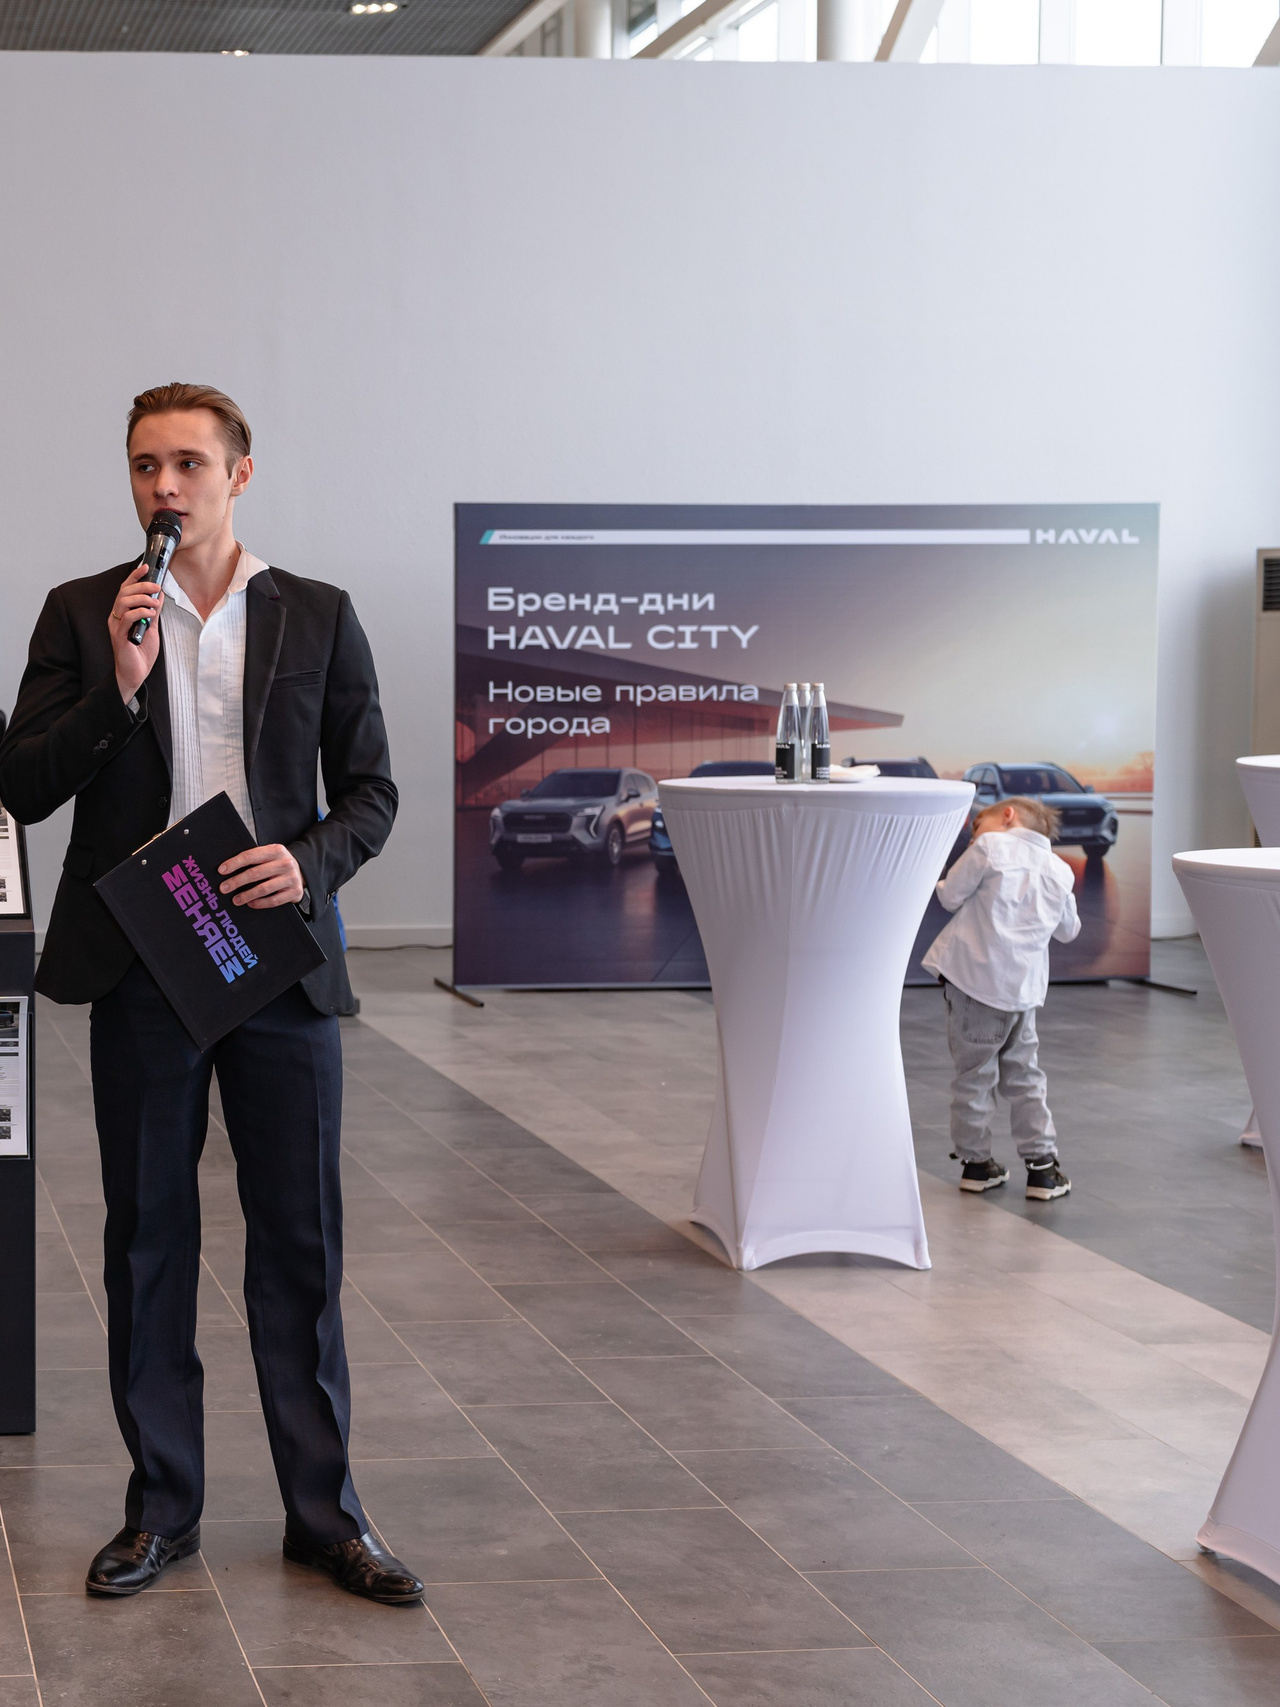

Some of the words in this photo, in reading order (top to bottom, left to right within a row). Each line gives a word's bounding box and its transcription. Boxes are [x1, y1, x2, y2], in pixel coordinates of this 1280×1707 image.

[1035, 528, 1140, 544] HAVAL
[487, 587, 716, 617] Бренд-дни
[487, 625, 632, 650] HAVAL
[647, 625, 760, 649] CITY
[488, 681, 602, 703] Новые
[615, 684, 759, 706] правила
[488, 716, 611, 739] города
[161, 864, 246, 984] МЕНЯЕМ
[182, 855, 219, 911] ЖИЗНЬ
[216, 909, 259, 969] ЛЮДЕЙ
